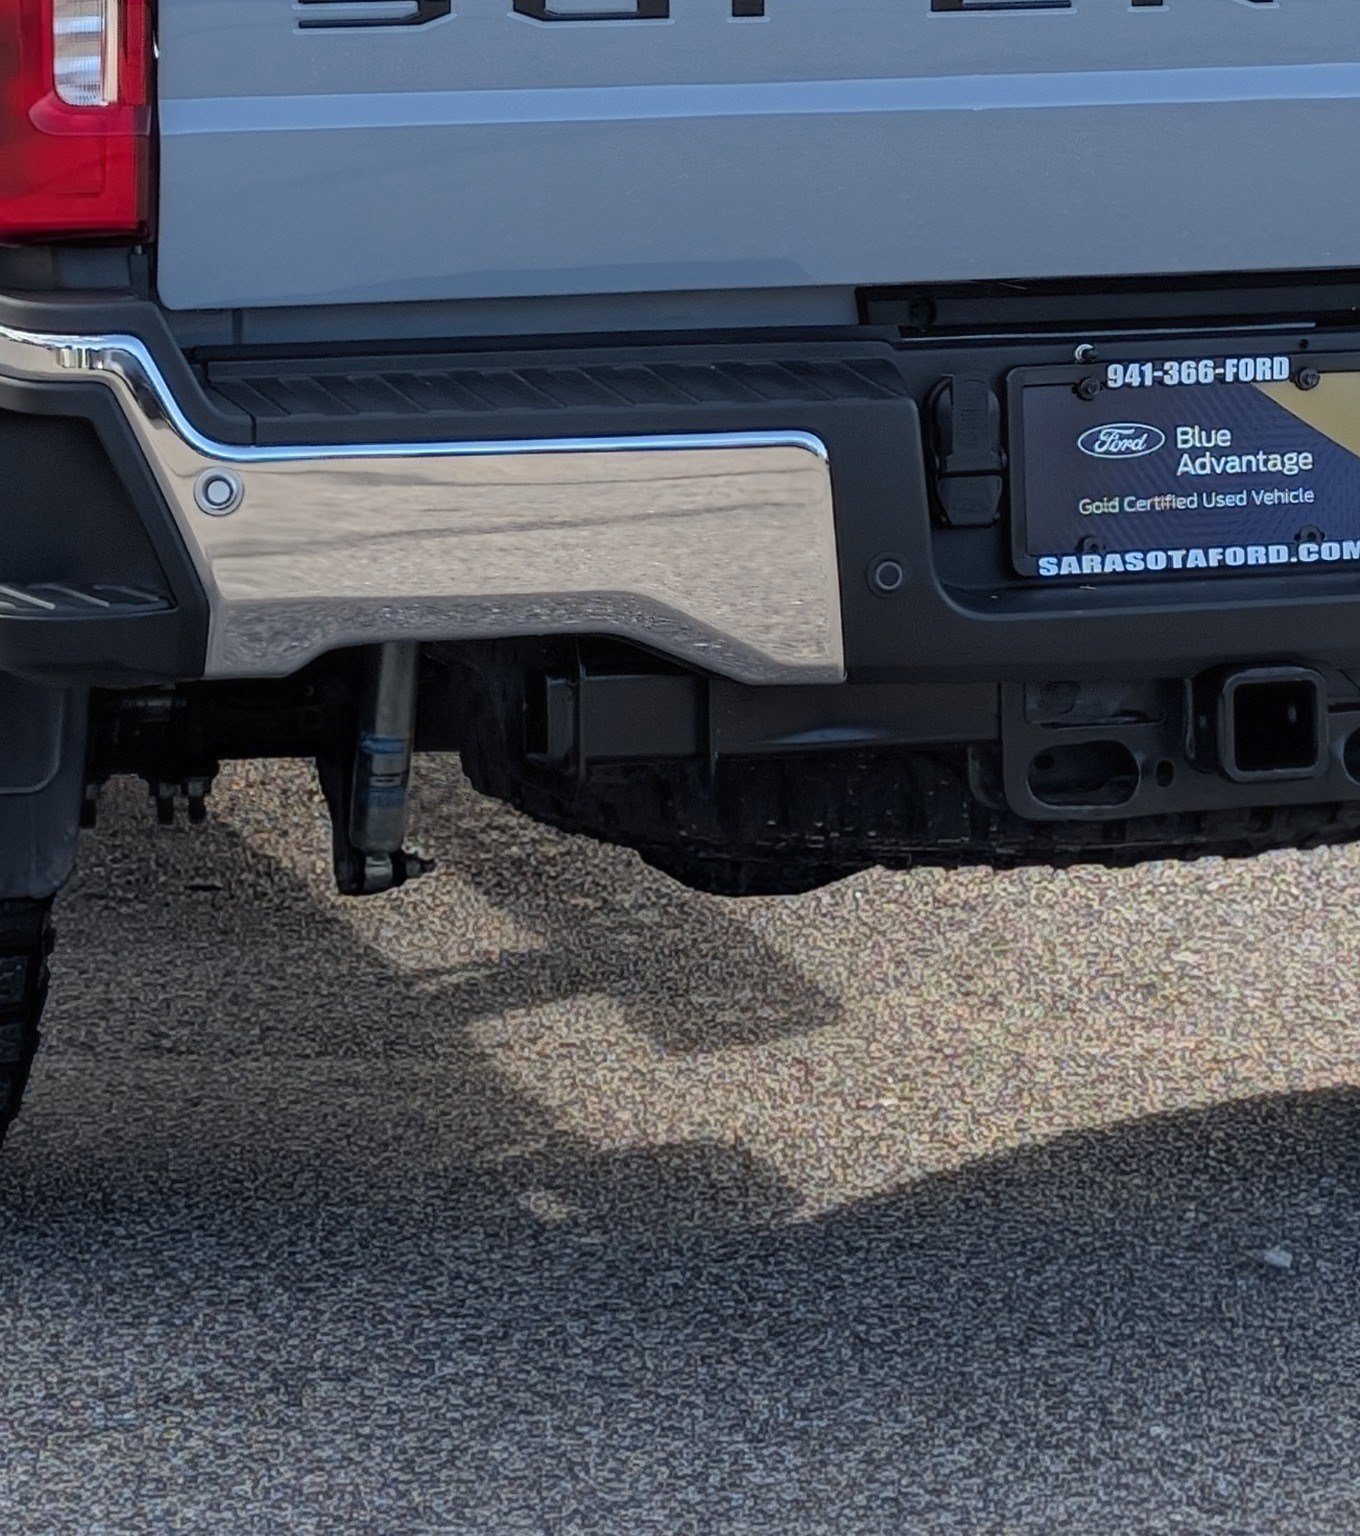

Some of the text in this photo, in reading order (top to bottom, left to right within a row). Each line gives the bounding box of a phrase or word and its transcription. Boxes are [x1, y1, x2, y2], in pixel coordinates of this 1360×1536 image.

[1106, 356, 1291, 390] 941-366-FORD
[1093, 428, 1148, 454] Ford
[1176, 426, 1232, 449] Blue
[1176, 449, 1314, 477] Advantage
[1079, 487, 1315, 516] Gold Certified Used Vehicle
